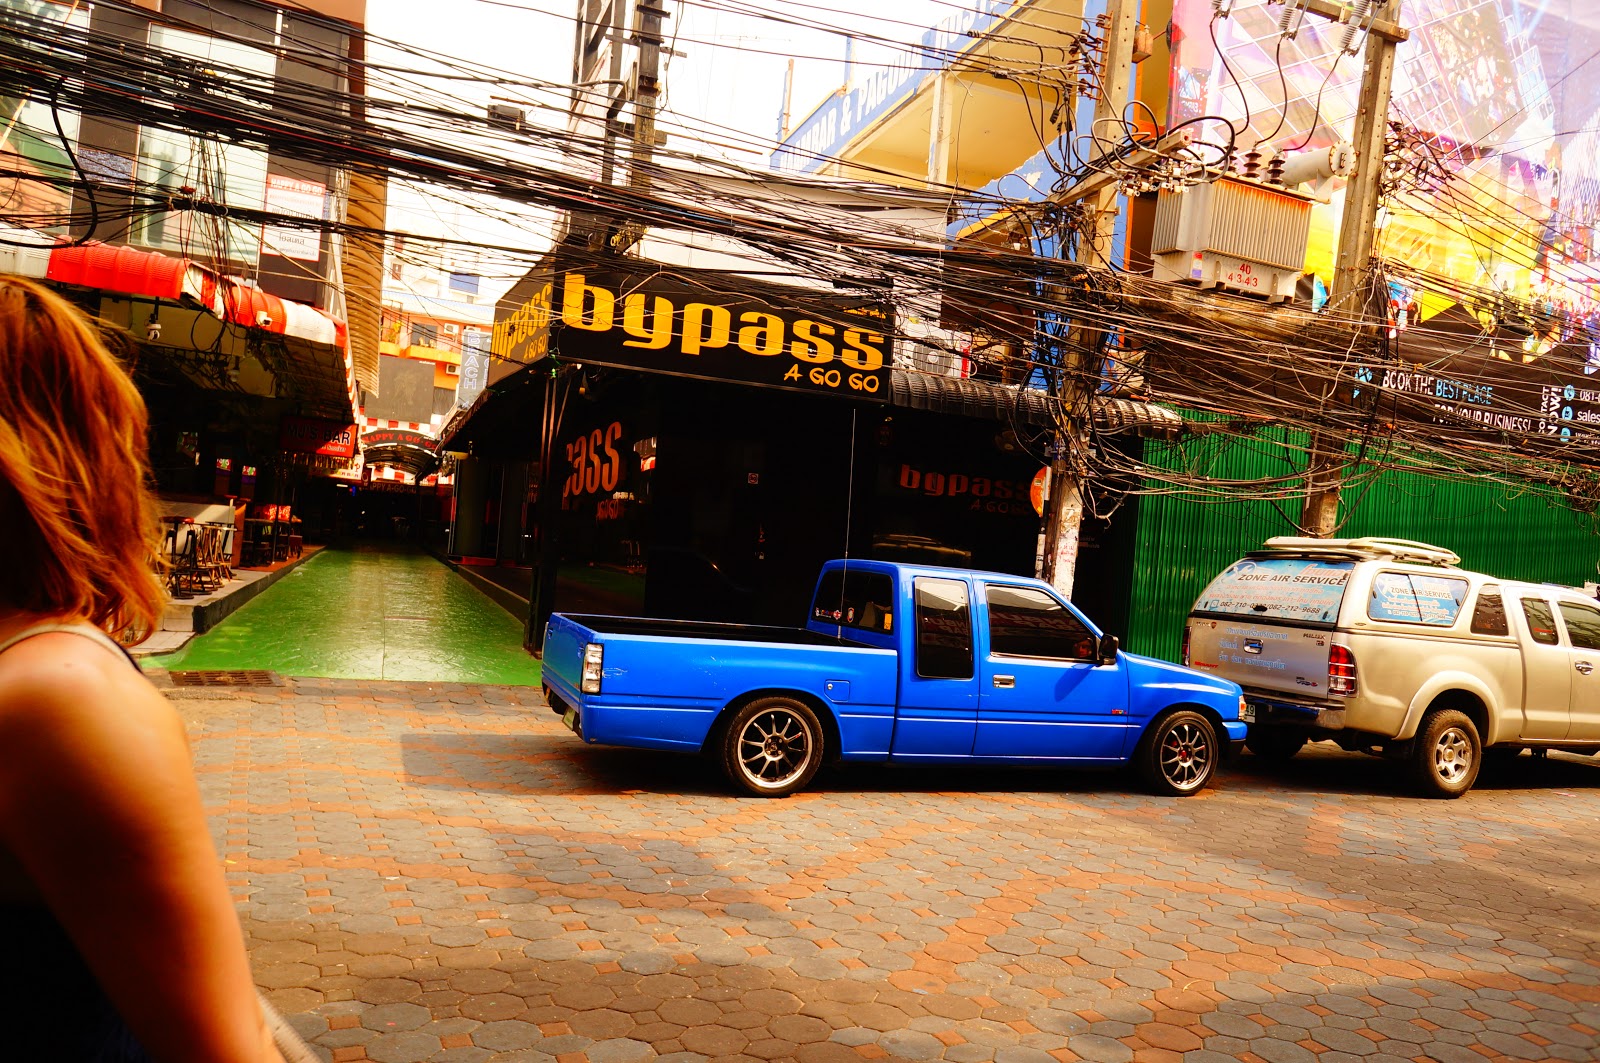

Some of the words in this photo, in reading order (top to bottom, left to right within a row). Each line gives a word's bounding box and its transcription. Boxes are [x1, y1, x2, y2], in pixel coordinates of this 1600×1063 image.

[1240, 263, 1251, 275] 40
[562, 271, 884, 372] bypass
[784, 363, 803, 382] A
[809, 367, 841, 388] GO
[848, 373, 880, 393] GO
[1436, 379, 1460, 400] BEST
[1238, 574, 1270, 582] ZONE
[1270, 574, 1290, 583] AIR
[1292, 576, 1348, 586] SERVICE
[1390, 586, 1409, 595] ZONE
